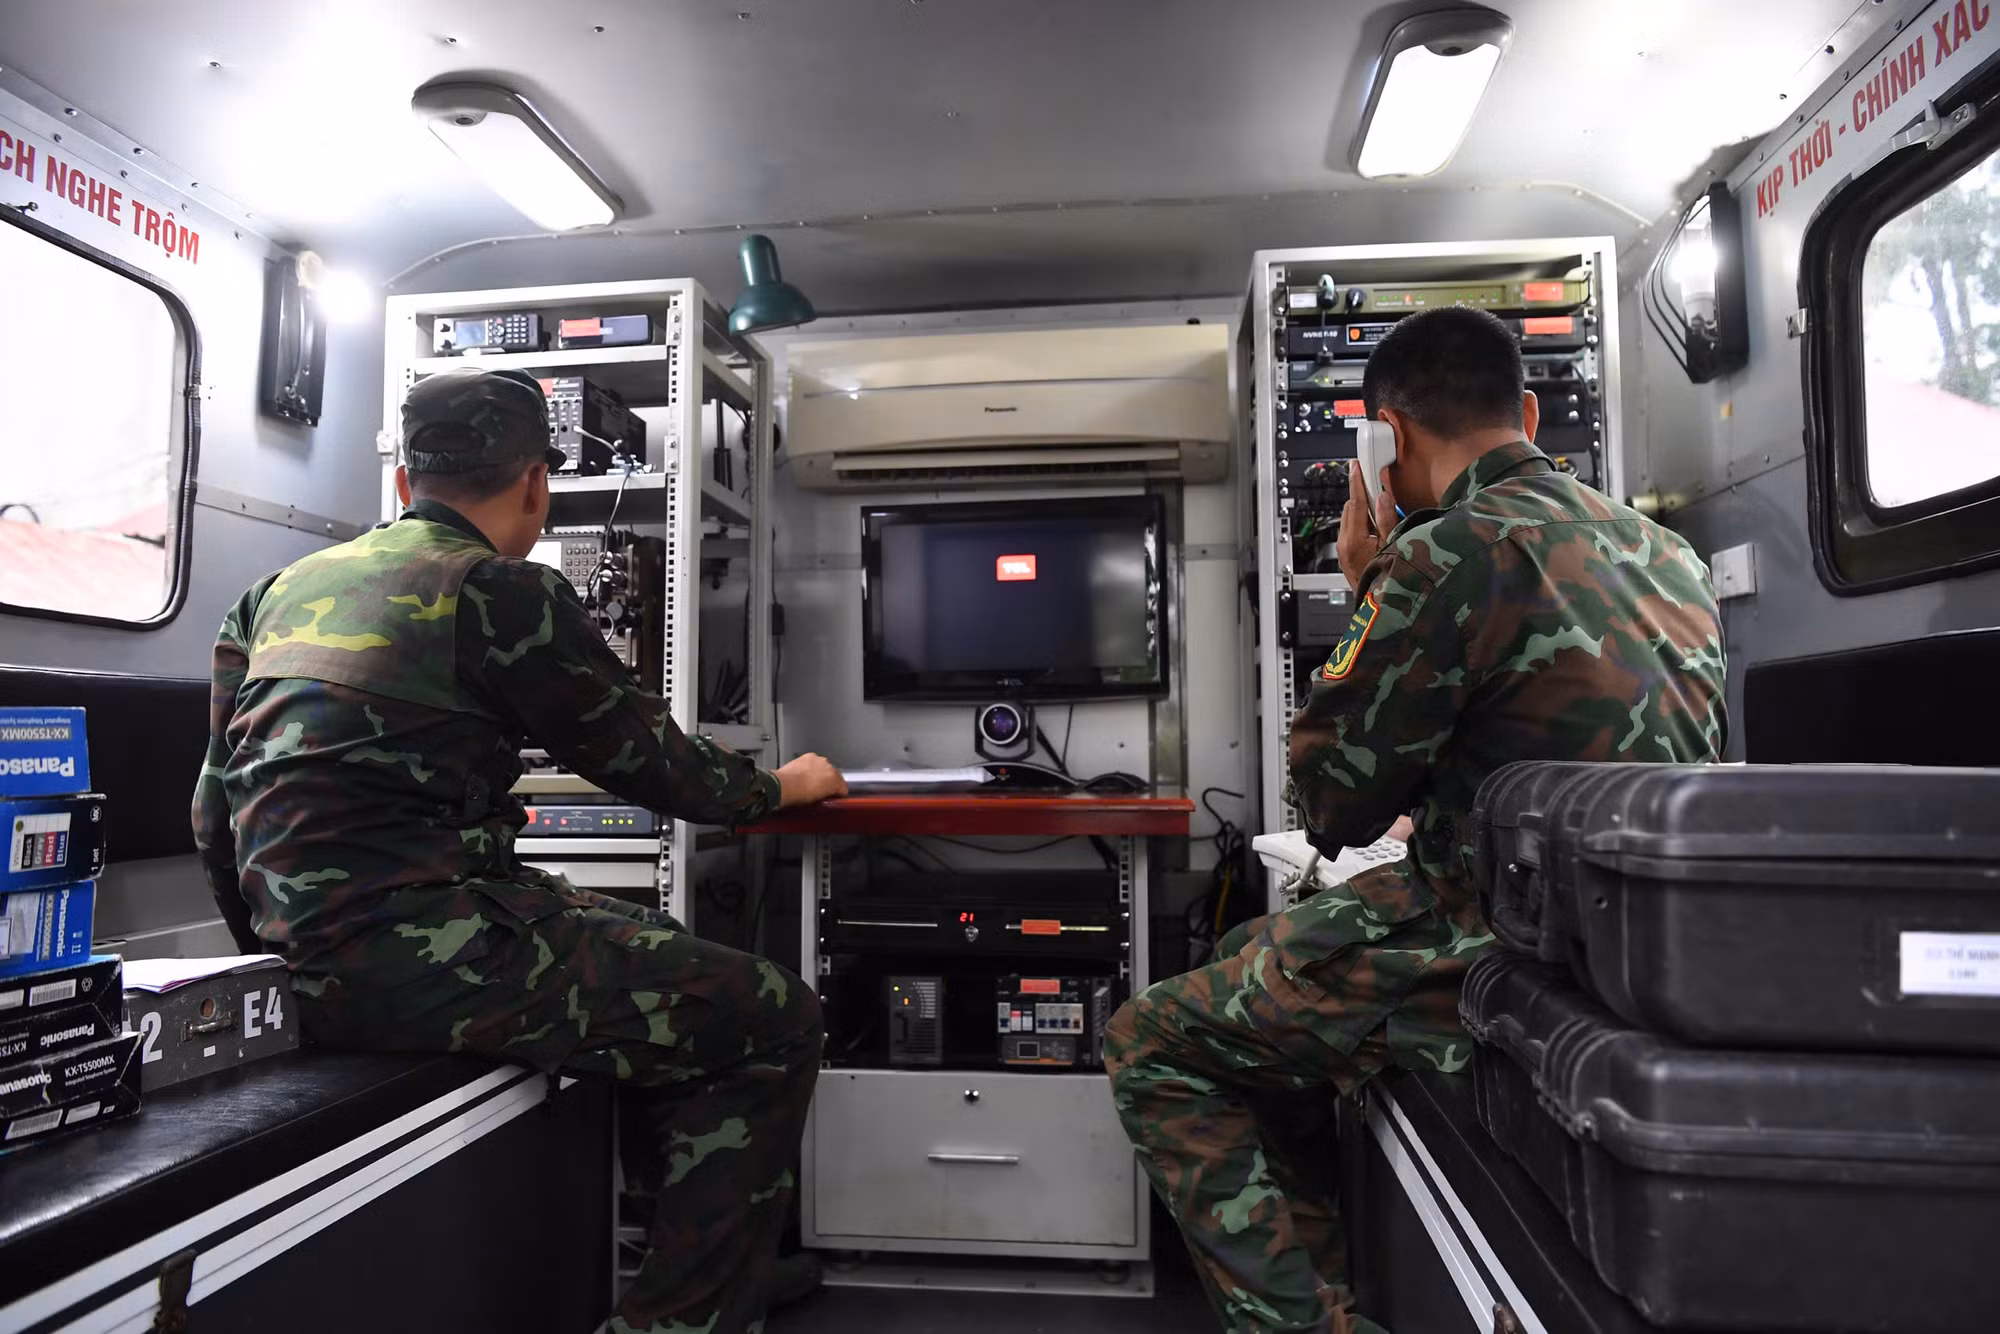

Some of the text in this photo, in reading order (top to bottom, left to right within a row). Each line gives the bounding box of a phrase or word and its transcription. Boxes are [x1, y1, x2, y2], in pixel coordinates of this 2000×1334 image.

[1757, 164, 1784, 219] KỊP
[1789, 118, 1833, 188] THỜI
[1852, 35, 1925, 133] CHÍNH
[46, 154, 122, 226] NGHE
[132, 198, 200, 264] TRỘM
[0, 756, 75, 777] Panaso
[23, 838, 33, 866] Black
[34, 838, 45, 864] Gray
[45, 835, 54, 863] Red
[56, 834, 65, 862] Blue
[92, 847, 100, 863] set
[56, 889, 70, 957] Panasonic
[244, 986, 283, 1039] E4
[40, 1023, 95, 1048] Panasonic
